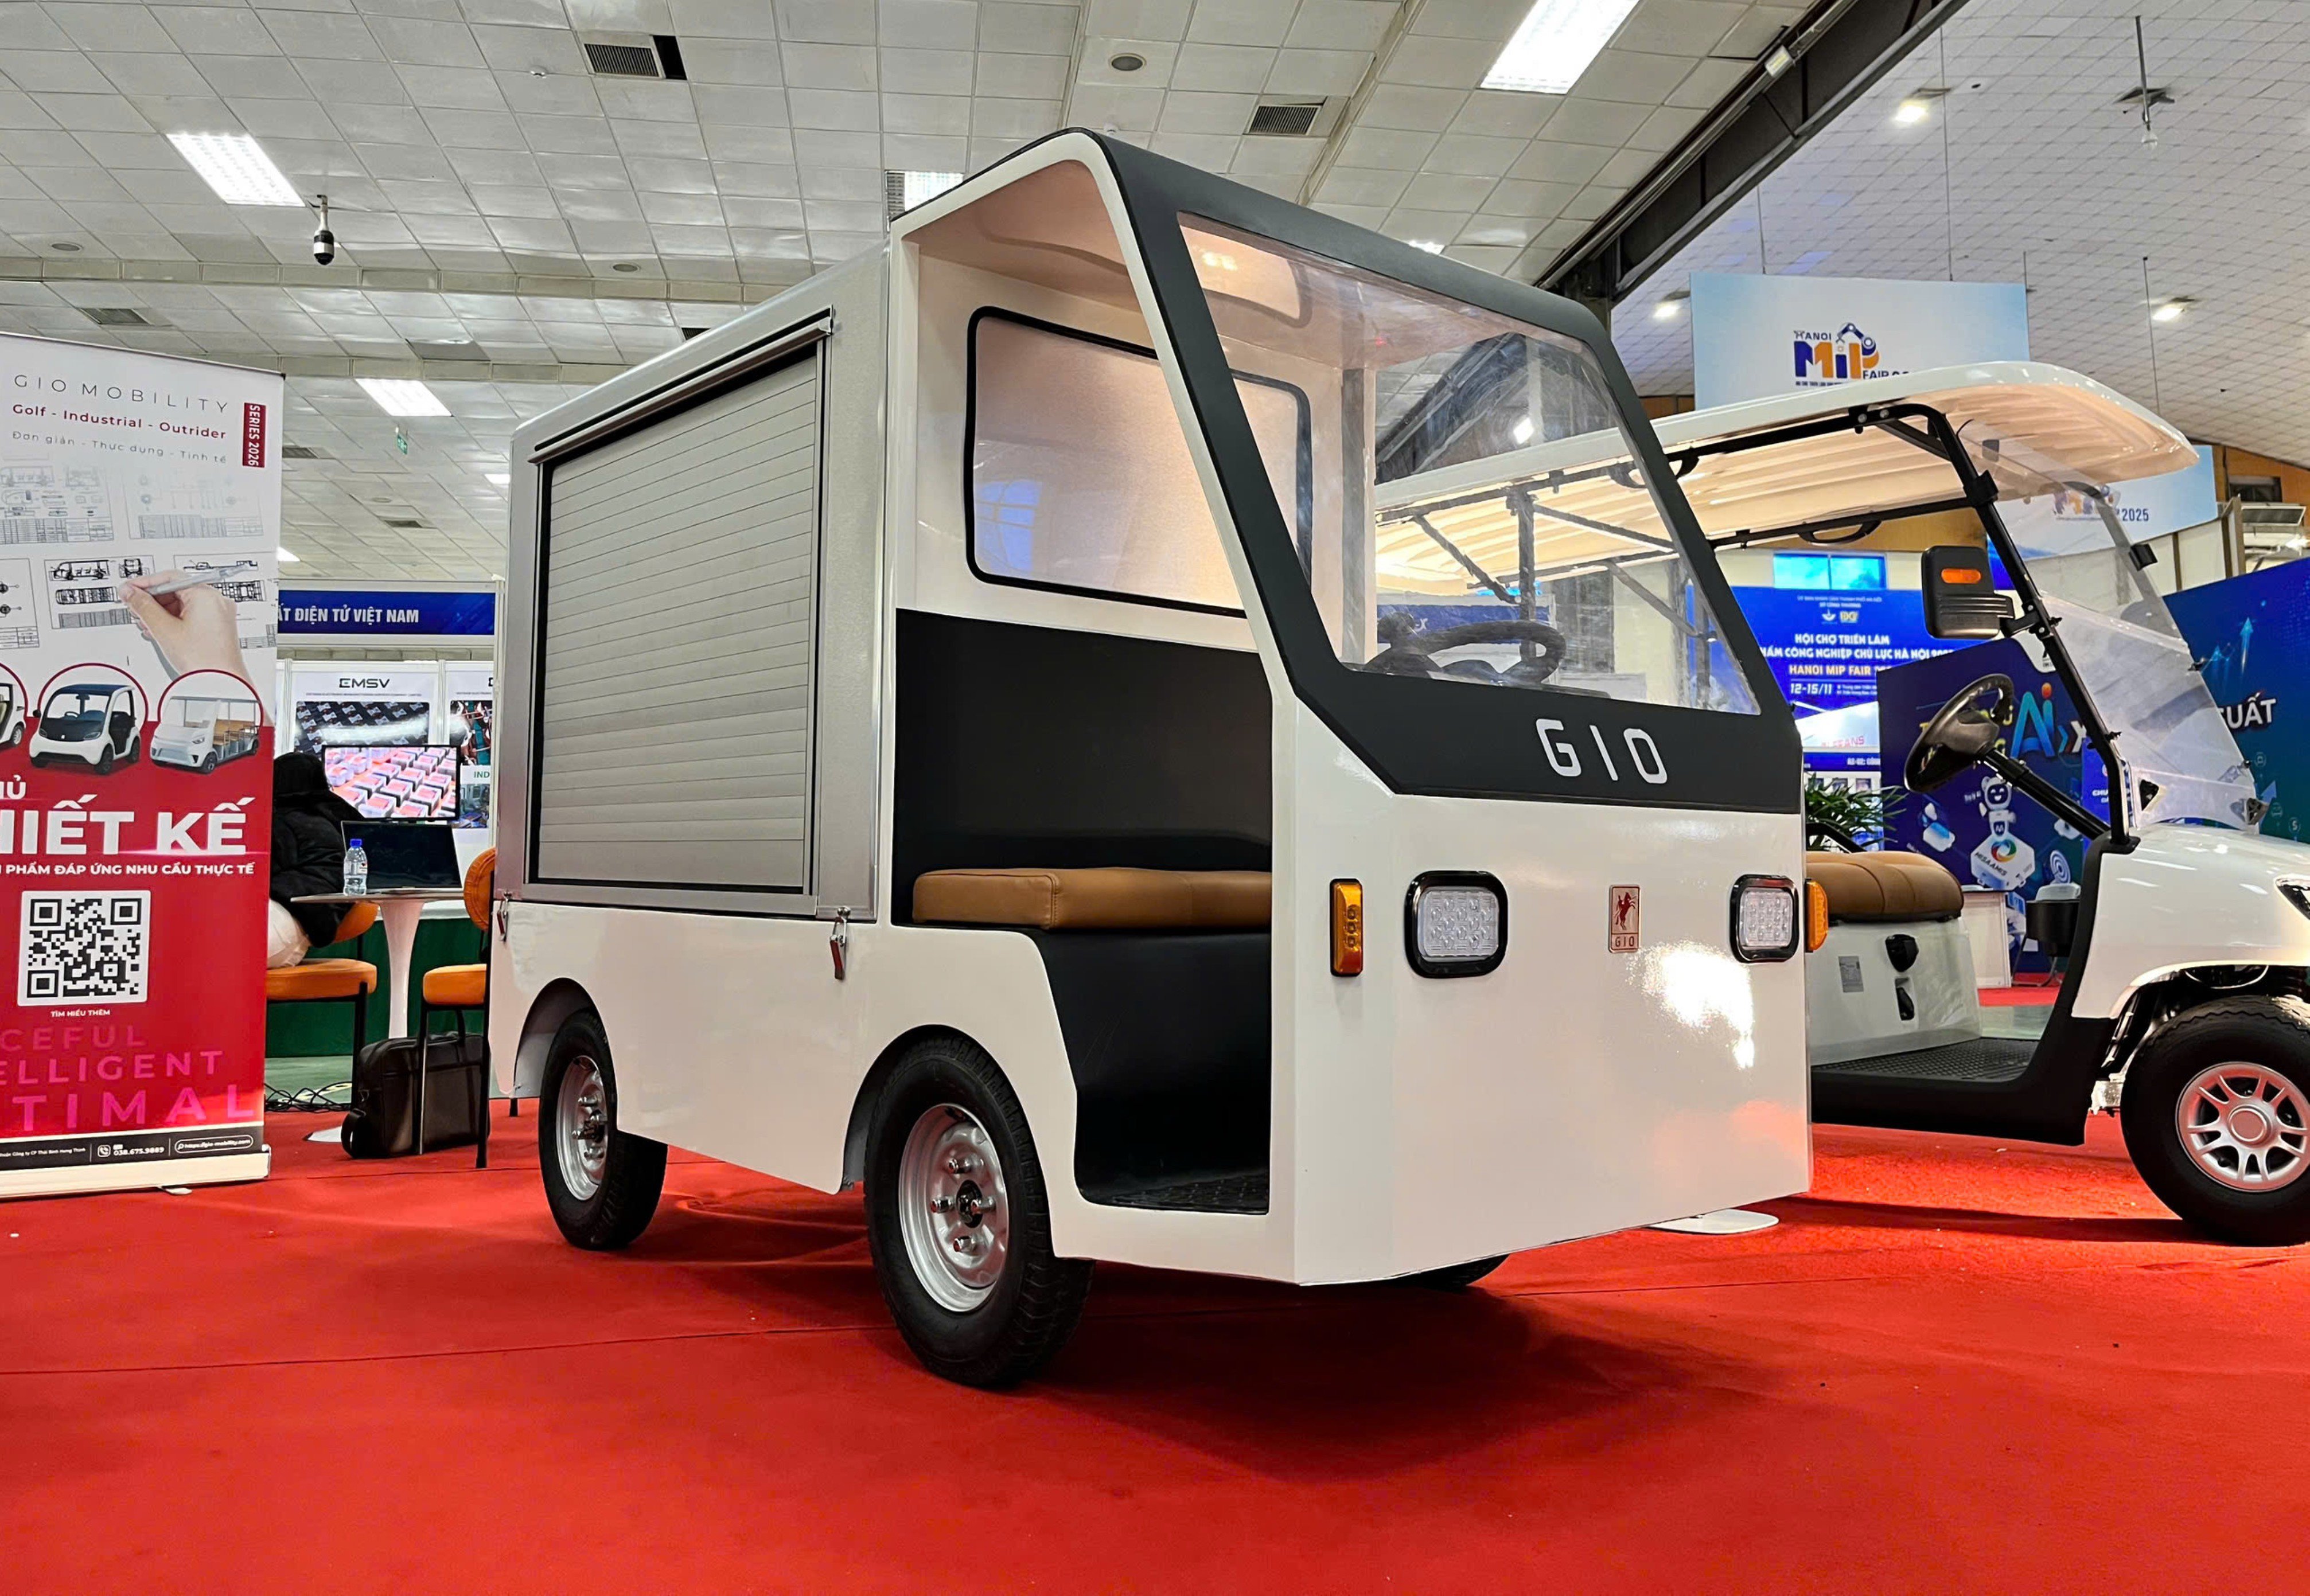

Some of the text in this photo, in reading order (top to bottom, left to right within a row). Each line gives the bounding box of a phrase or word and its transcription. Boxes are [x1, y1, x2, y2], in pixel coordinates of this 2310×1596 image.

[14, 374, 227, 413] GIO MOBILITY
[13, 404, 226, 439] Golf Industrial Outrider
[247, 404, 261, 466] SERIES 2026
[2122, 508, 2149, 521] 2025
[295, 606, 328, 625] ĐIỆN
[332, 604, 351, 622] TỬ
[353, 606, 383, 626] VIỆT
[387, 609, 419, 623] NAM
[1785, 646, 1814, 658] CÔNG
[1789, 665, 1823, 675] HANOI
[1826, 665, 1845, 676] MIP
[1849, 665, 1871, 676] FAIR
[338, 678, 390, 688] EMSV
[1790, 683, 1832, 694] 12-15/11
[2217, 692, 2277, 729] UẤT
[1536, 719, 1668, 784] GIO
[156, 797, 256, 855] KẾ
[54, 863, 86, 875] ĐÁP
[90, 863, 122, 875] ỨNG
[126, 864, 158, 875] NHU
[194, 863, 233, 876] THỰC
[237, 861, 255, 874] TẾ
[1615, 936, 1634, 947] GIO
